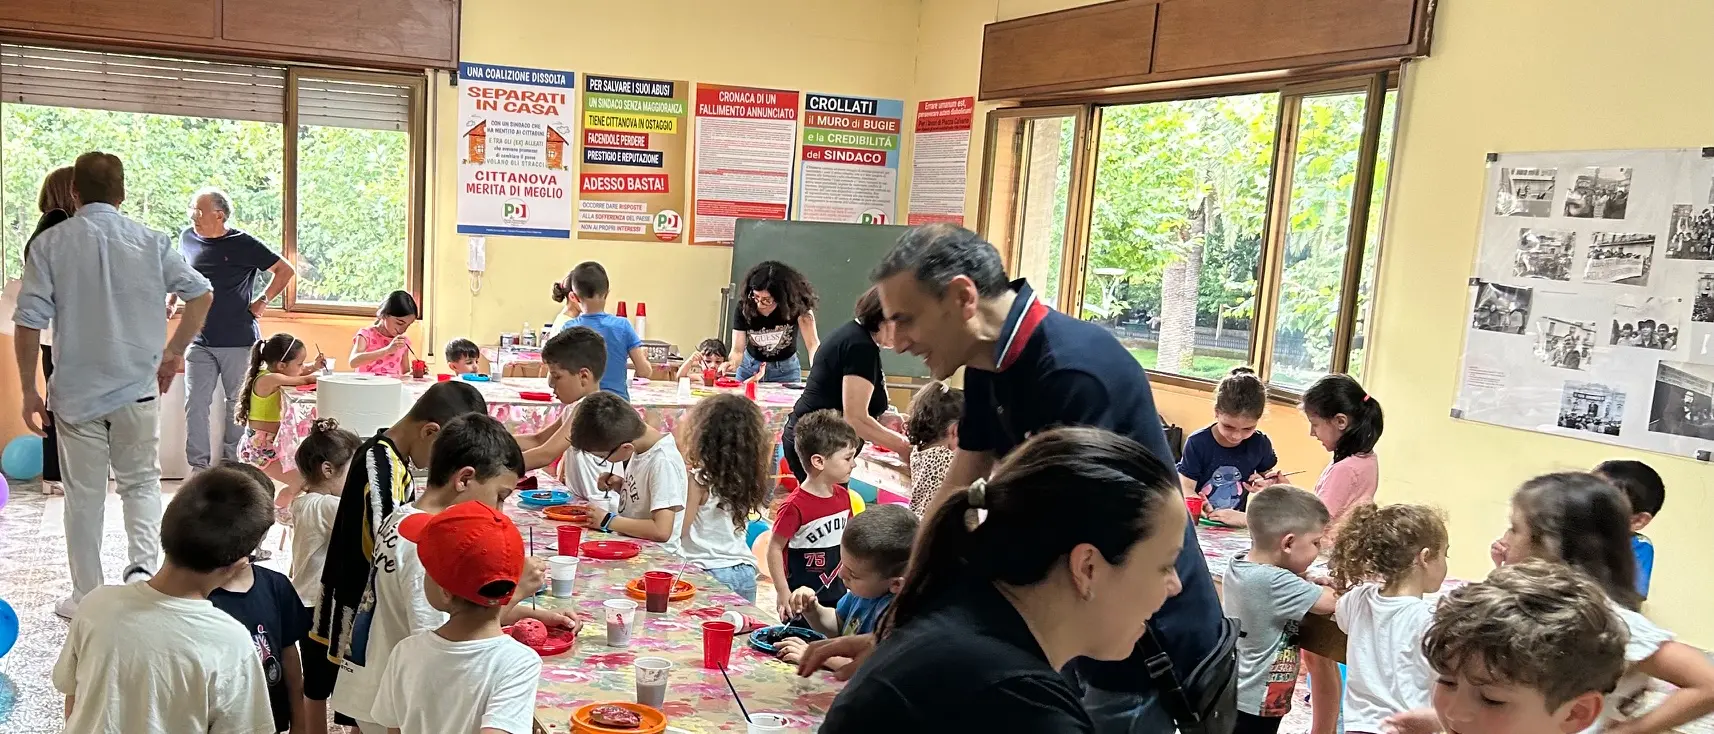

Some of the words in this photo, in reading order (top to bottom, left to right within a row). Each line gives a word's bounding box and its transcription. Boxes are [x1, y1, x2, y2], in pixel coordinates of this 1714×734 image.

[467, 66, 483, 78] UNA
[485, 68, 530, 82] COALIZIONE
[532, 72, 566, 85] DISSOLTA
[590, 78, 602, 91] PER
[603, 80, 630, 93] SALVARE
[632, 82, 635, 93] I
[636, 83, 650, 94] SUOI
[651, 84, 670, 96] ABUSI
[467, 86, 566, 105] SEPARATI
[719, 91, 755, 104] CRONACA
[756, 93, 764, 104] DI
[766, 94, 776, 105] UN
[476, 99, 498, 111] IN
[503, 102, 559, 116] CASA
[588, 97, 597, 108] UN
[598, 98, 622, 110] SINDACO
[624, 100, 642, 110] SENZA
[642, 102, 682, 114] MAGGIORANZA
[700, 104, 746, 116] FALLIMENTO
[746, 106, 794, 119] ANNUNCIATO
[810, 96, 873, 114] CROLLATI
[589, 115, 604, 126] TIENE
[606, 116, 637, 128] CITTANOVA
[638, 119, 644, 129] IN
[645, 119, 672, 130] OSTAGGIO
[808, 116, 814, 125] il
[818, 116, 849, 127] MURO
[852, 119, 860, 129] di
[864, 120, 896, 131] BUGIE
[588, 132, 619, 145] FACENDOLE
[620, 134, 645, 147] PERDERE
[816, 133, 824, 142] la
[588, 150, 616, 161] PRESTIGIO
[618, 152, 621, 161] E
[622, 152, 659, 164] REPUTAZIONE
[806, 151, 820, 159] del
[824, 150, 882, 163] SINDACO
[475, 170, 557, 185] CITTANOVA
[583, 177, 625, 190] ADESSO
[628, 178, 664, 190] BASTA!
[467, 183, 506, 196] MERITA
[510, 186, 520, 196] DI
[525, 187, 563, 199] MEGLIO
[505, 203, 526, 218] PD
[658, 214, 678, 228] PD
[755, 334, 780, 342] GUESS
[804, 552, 826, 567] 75
